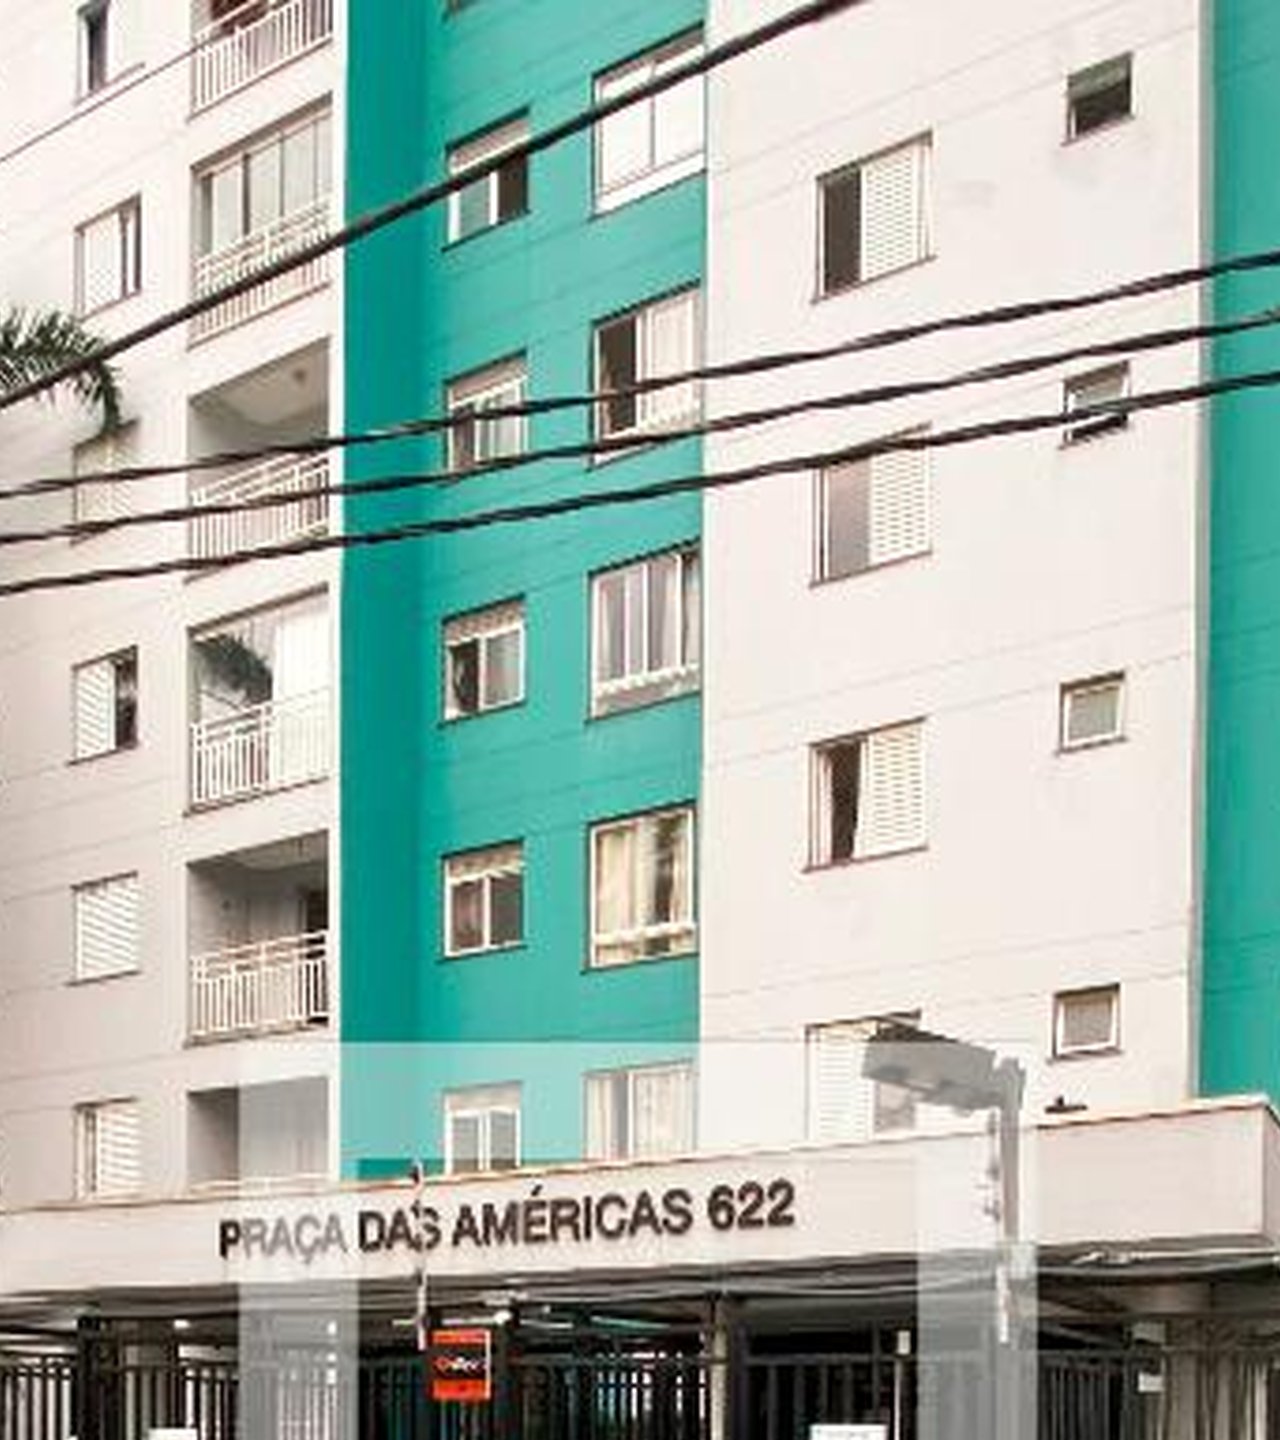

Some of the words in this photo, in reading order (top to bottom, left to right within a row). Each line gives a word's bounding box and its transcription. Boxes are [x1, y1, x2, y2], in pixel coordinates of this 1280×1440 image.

[219, 1213, 348, 1265] PRAÇA
[358, 1205, 440, 1253] DAS
[452, 1184, 694, 1248] AMÉRICAS
[707, 1178, 796, 1232] 622
